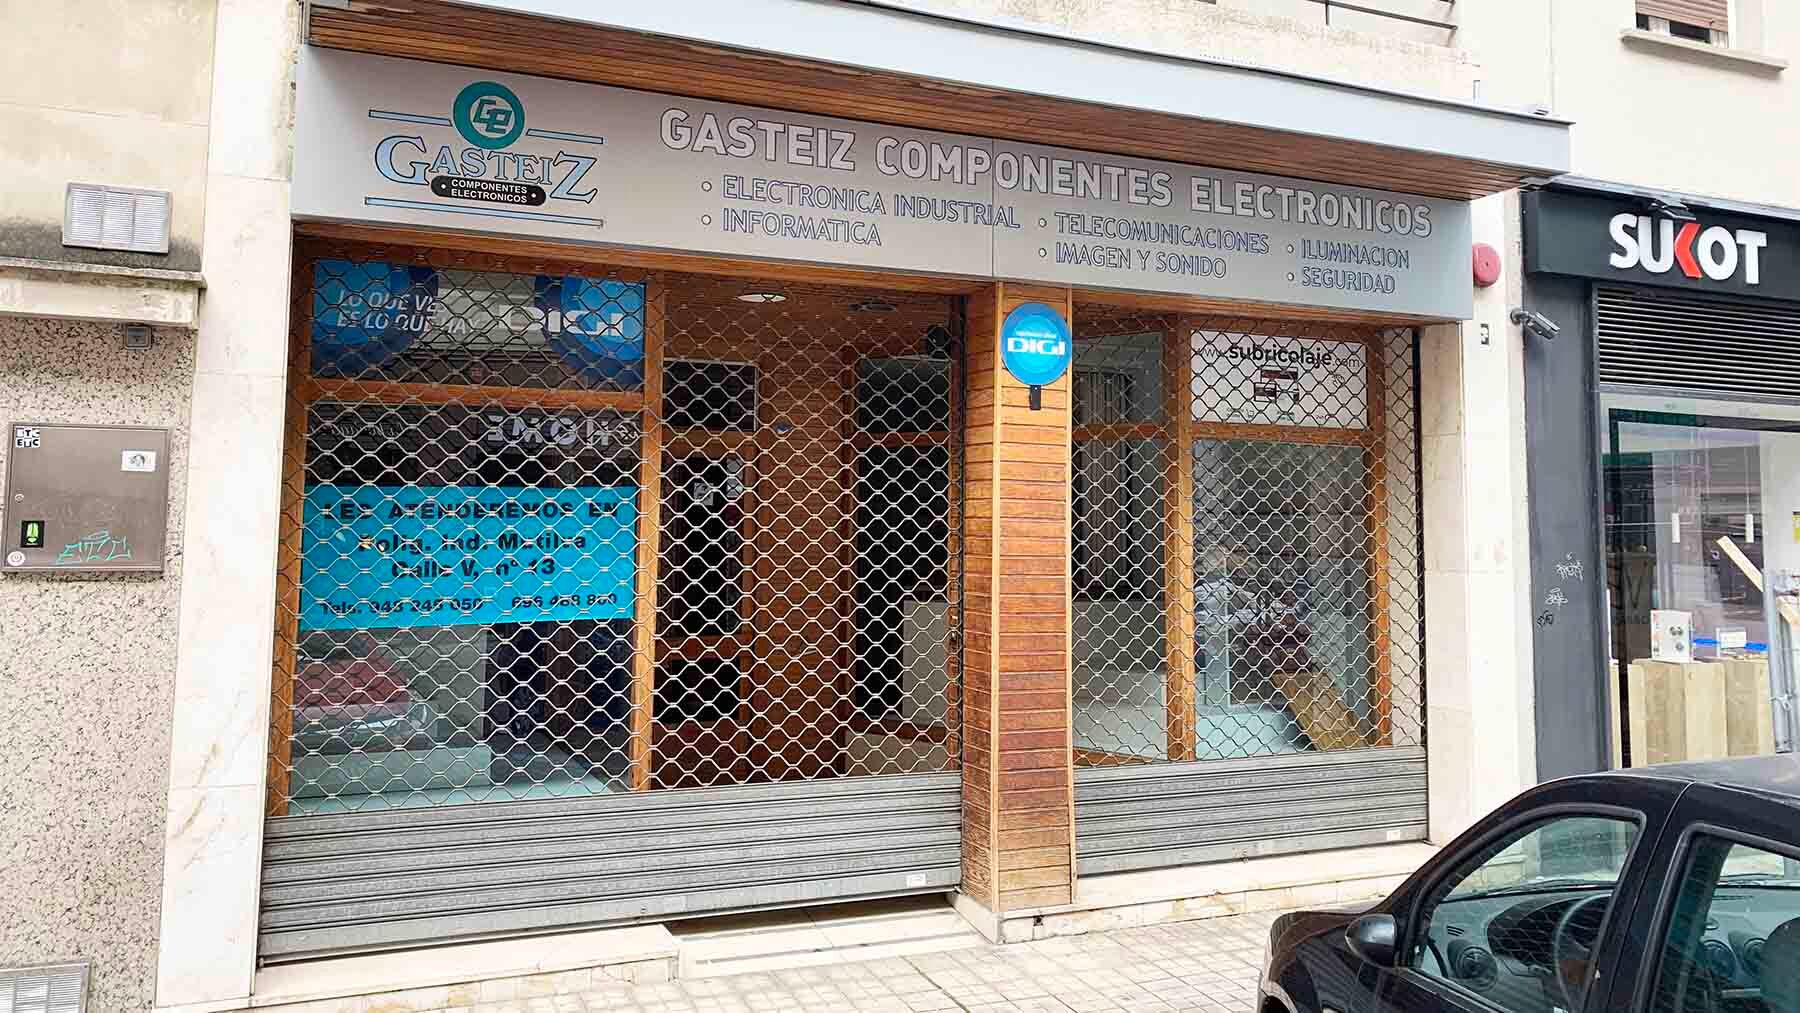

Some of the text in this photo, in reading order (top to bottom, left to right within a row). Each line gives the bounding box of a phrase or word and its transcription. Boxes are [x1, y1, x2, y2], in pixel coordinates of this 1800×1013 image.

[374, 134, 599, 204] GASTEIZ
[660, 108, 1433, 238] GASTEIZ COMPONENTES ELECTRONICOS
[450, 178, 528, 194] COMPONENTES
[450, 188, 528, 204] ELECTRONICOS
[722, 174, 1021, 229] ELECTRONICA INDUSTRIAL
[722, 208, 882, 246] INFORMATICA
[1054, 211, 1270, 255] TELECOMUNICACIONES
[1055, 243, 1227, 280] IMAGEN Y SONIDO
[1301, 239, 1410, 270] ILUMINACION
[1301, 266, 1395, 295] SEGURIDAD
[368, 292, 410, 311] QUE
[364, 312, 389, 329] LO
[1007, 337, 1066, 355] DIGI
[588, 502, 618, 518] EN
